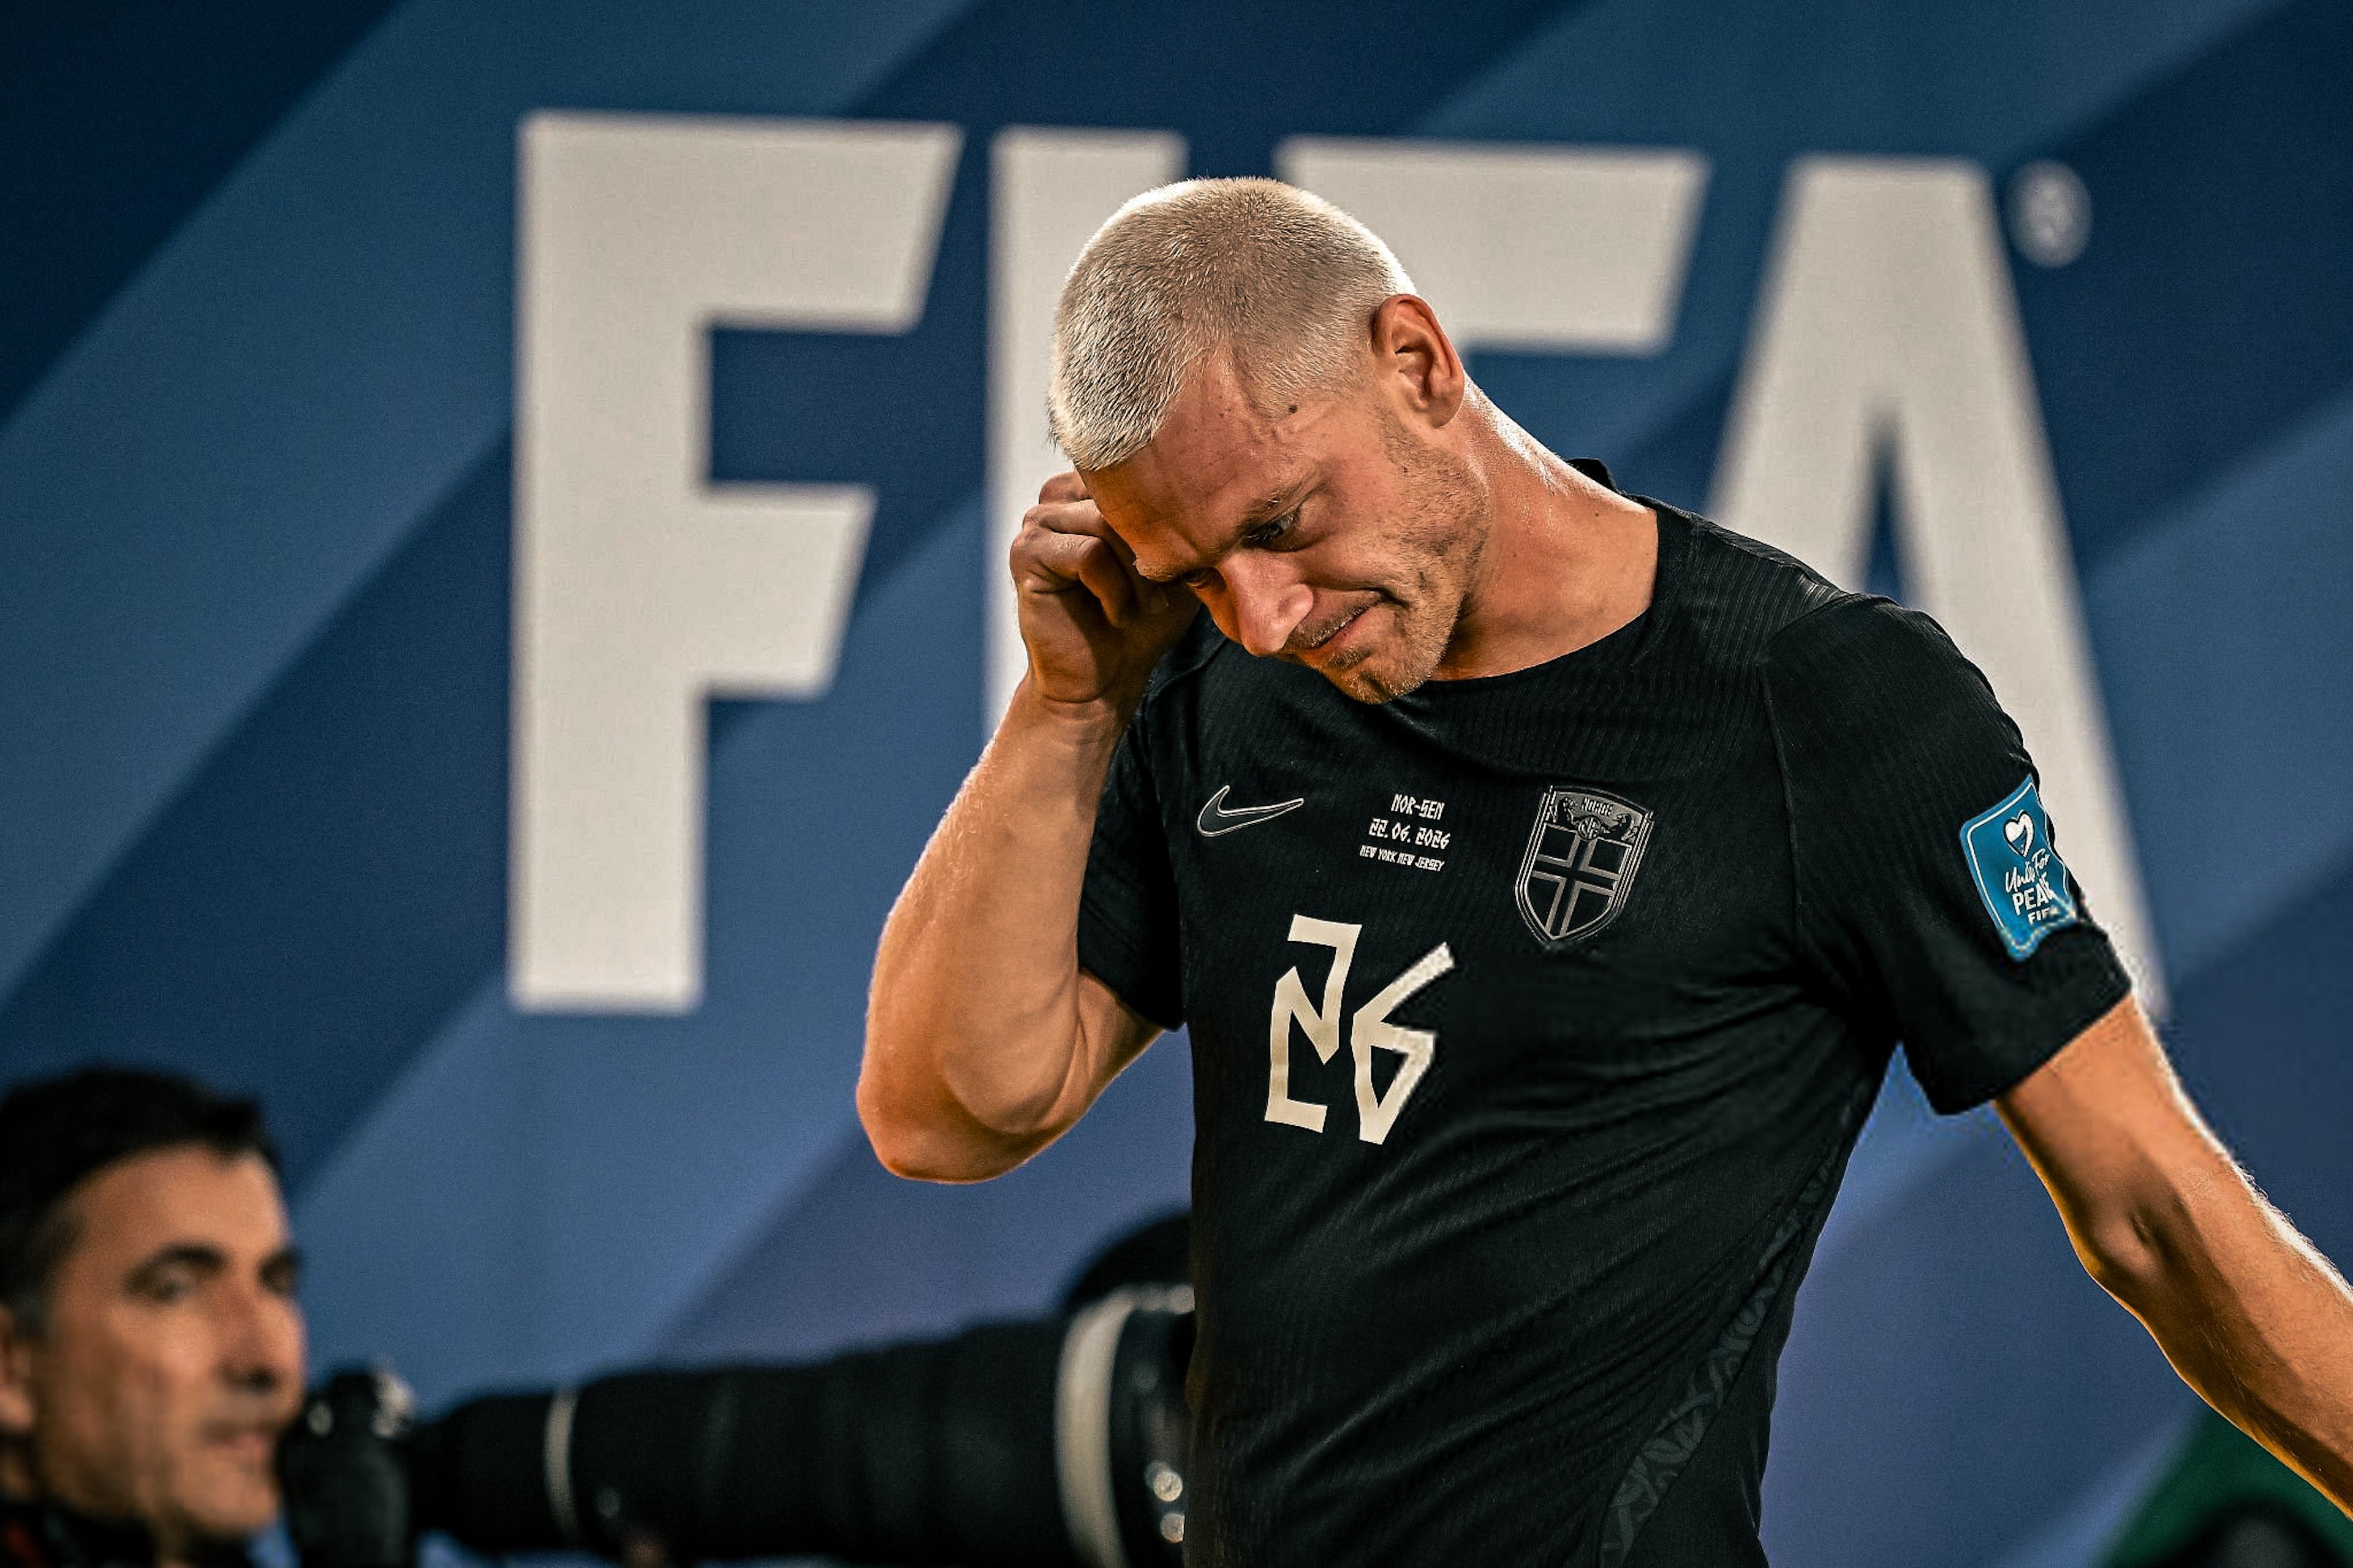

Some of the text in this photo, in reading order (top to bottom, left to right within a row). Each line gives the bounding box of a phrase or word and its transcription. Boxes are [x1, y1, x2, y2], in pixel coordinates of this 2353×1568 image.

[1390, 793, 1445, 820] NOR-SEN
[1359, 844, 1445, 871] NEW YORK NEW JERSEY
[2027, 905, 2059, 924] FIF
[1264, 914, 1455, 1145] 26
